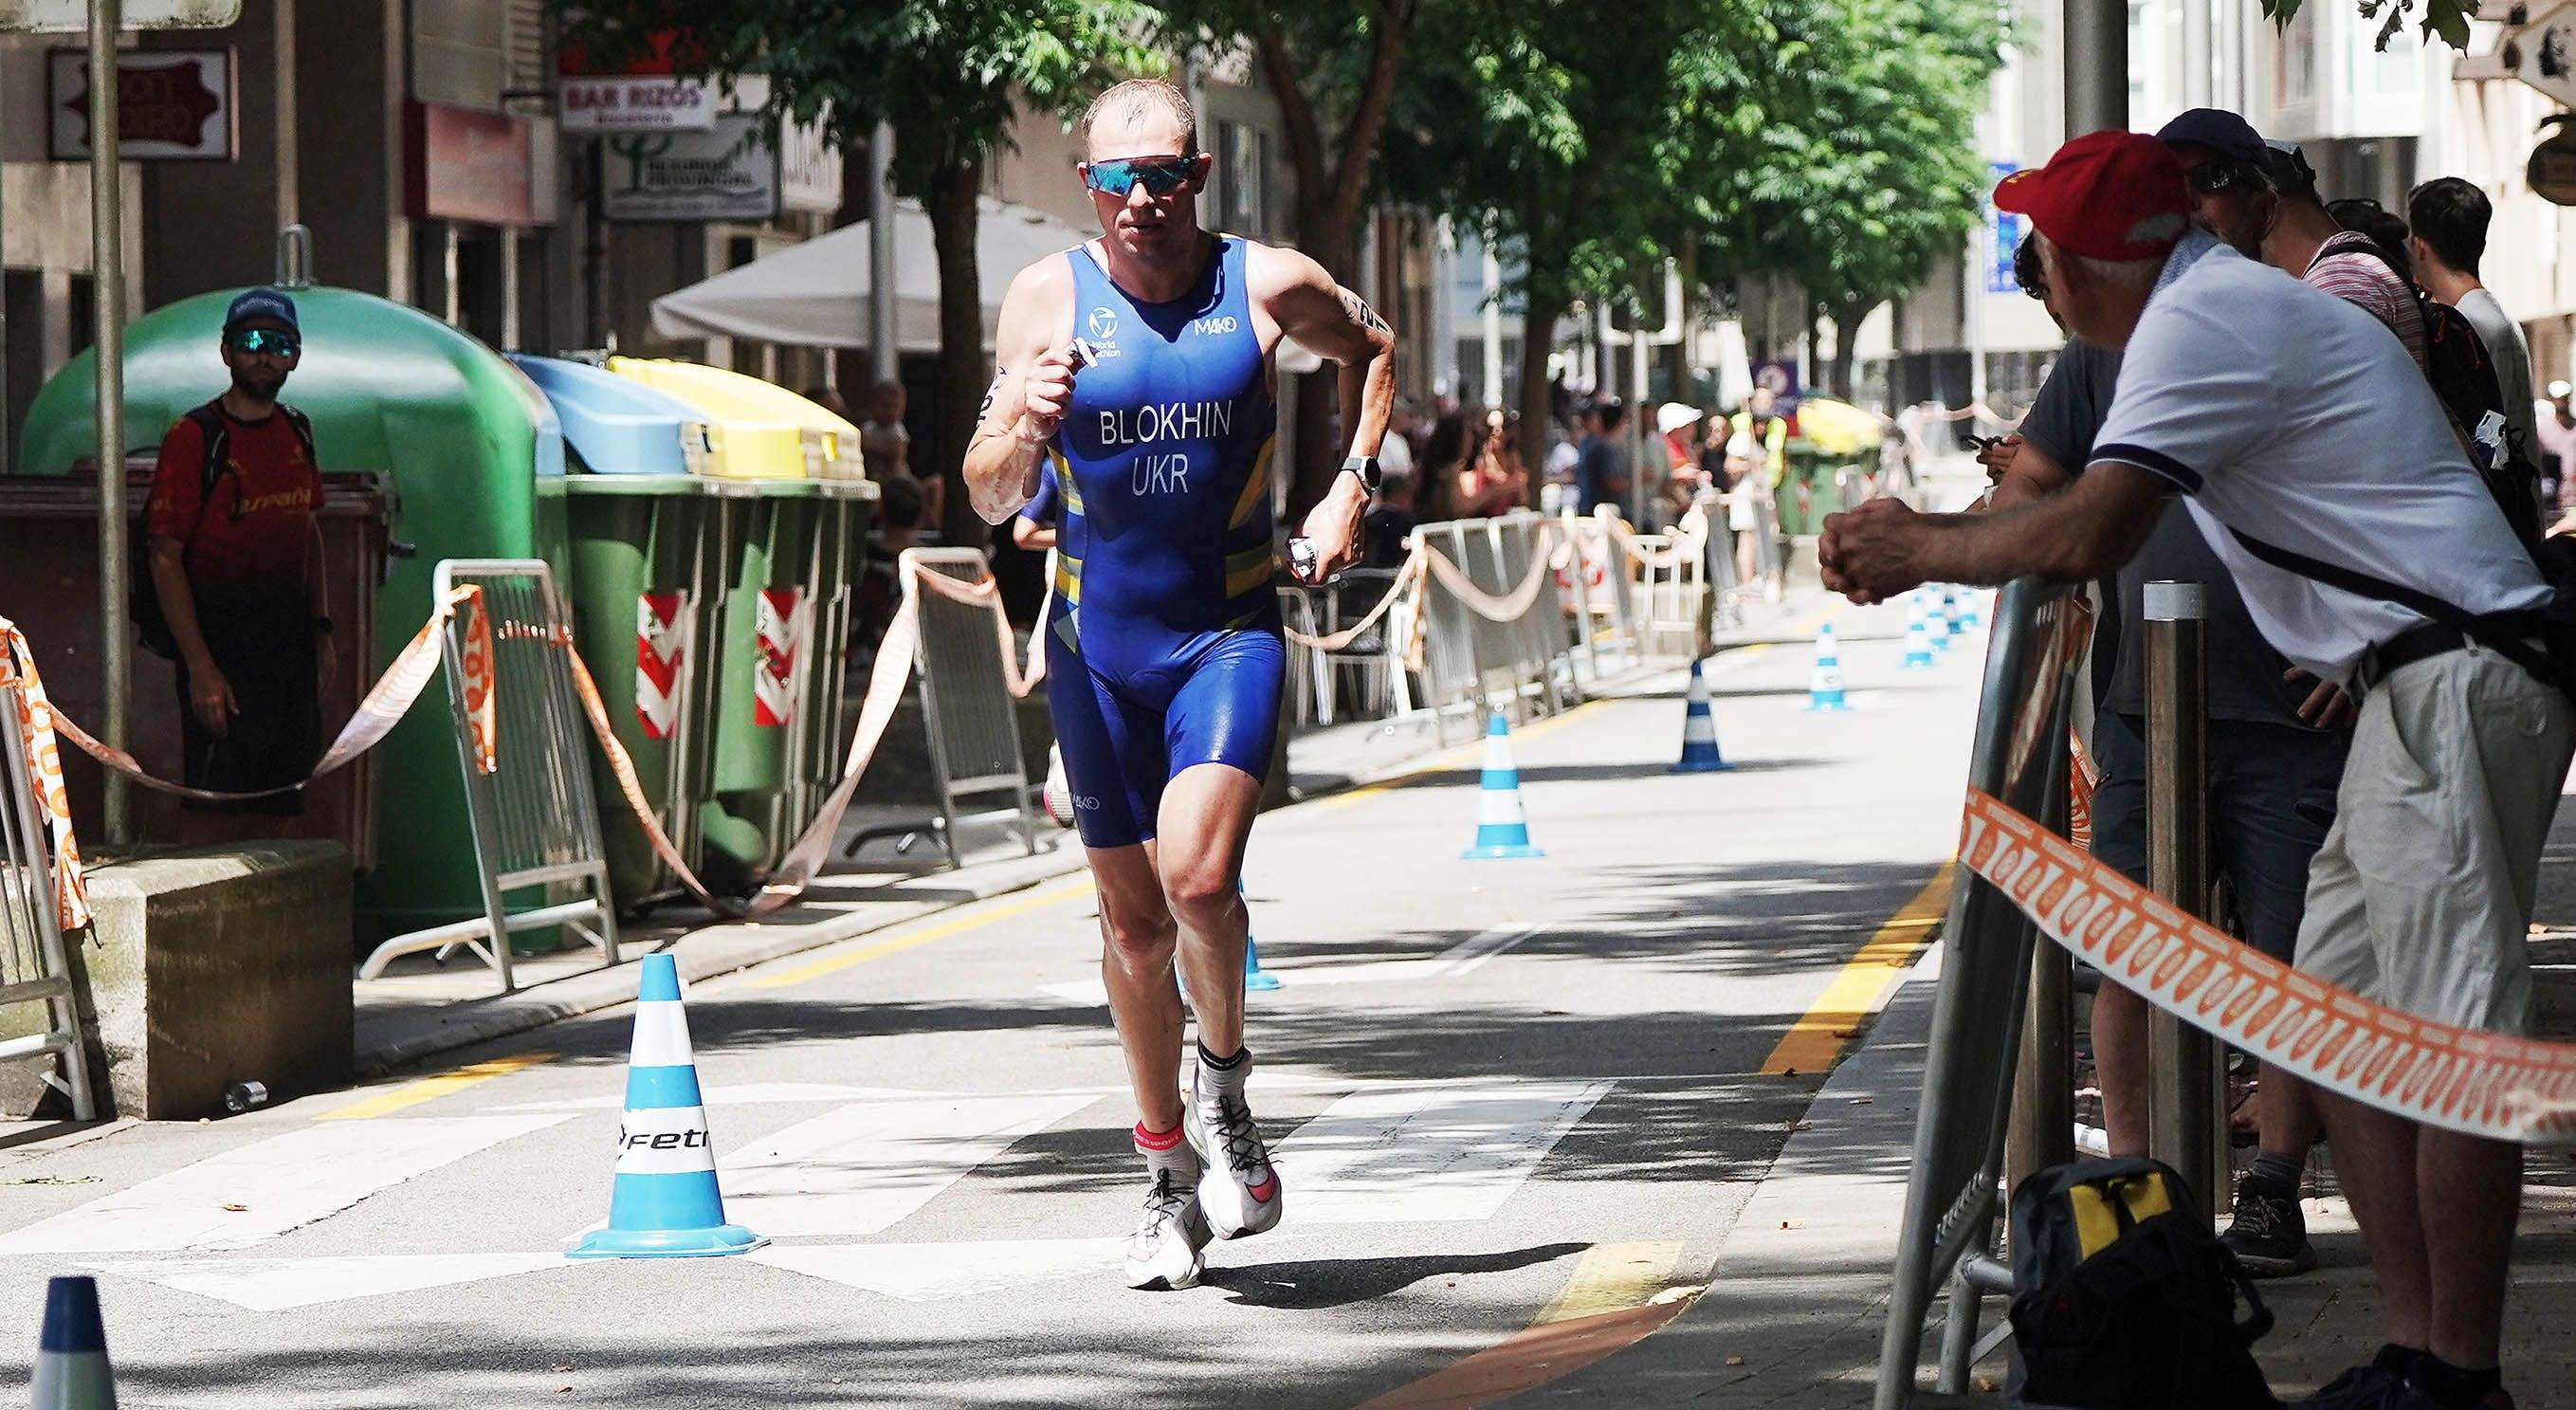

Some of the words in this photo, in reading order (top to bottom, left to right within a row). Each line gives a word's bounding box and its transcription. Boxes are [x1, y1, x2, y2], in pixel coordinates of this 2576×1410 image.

[568, 85, 619, 109] BAR
[629, 83, 702, 107] RIZOS
[1194, 316, 1237, 336] MAKO
[1100, 399, 1232, 445] BLOKHIN
[1132, 453, 1188, 496] UKR
